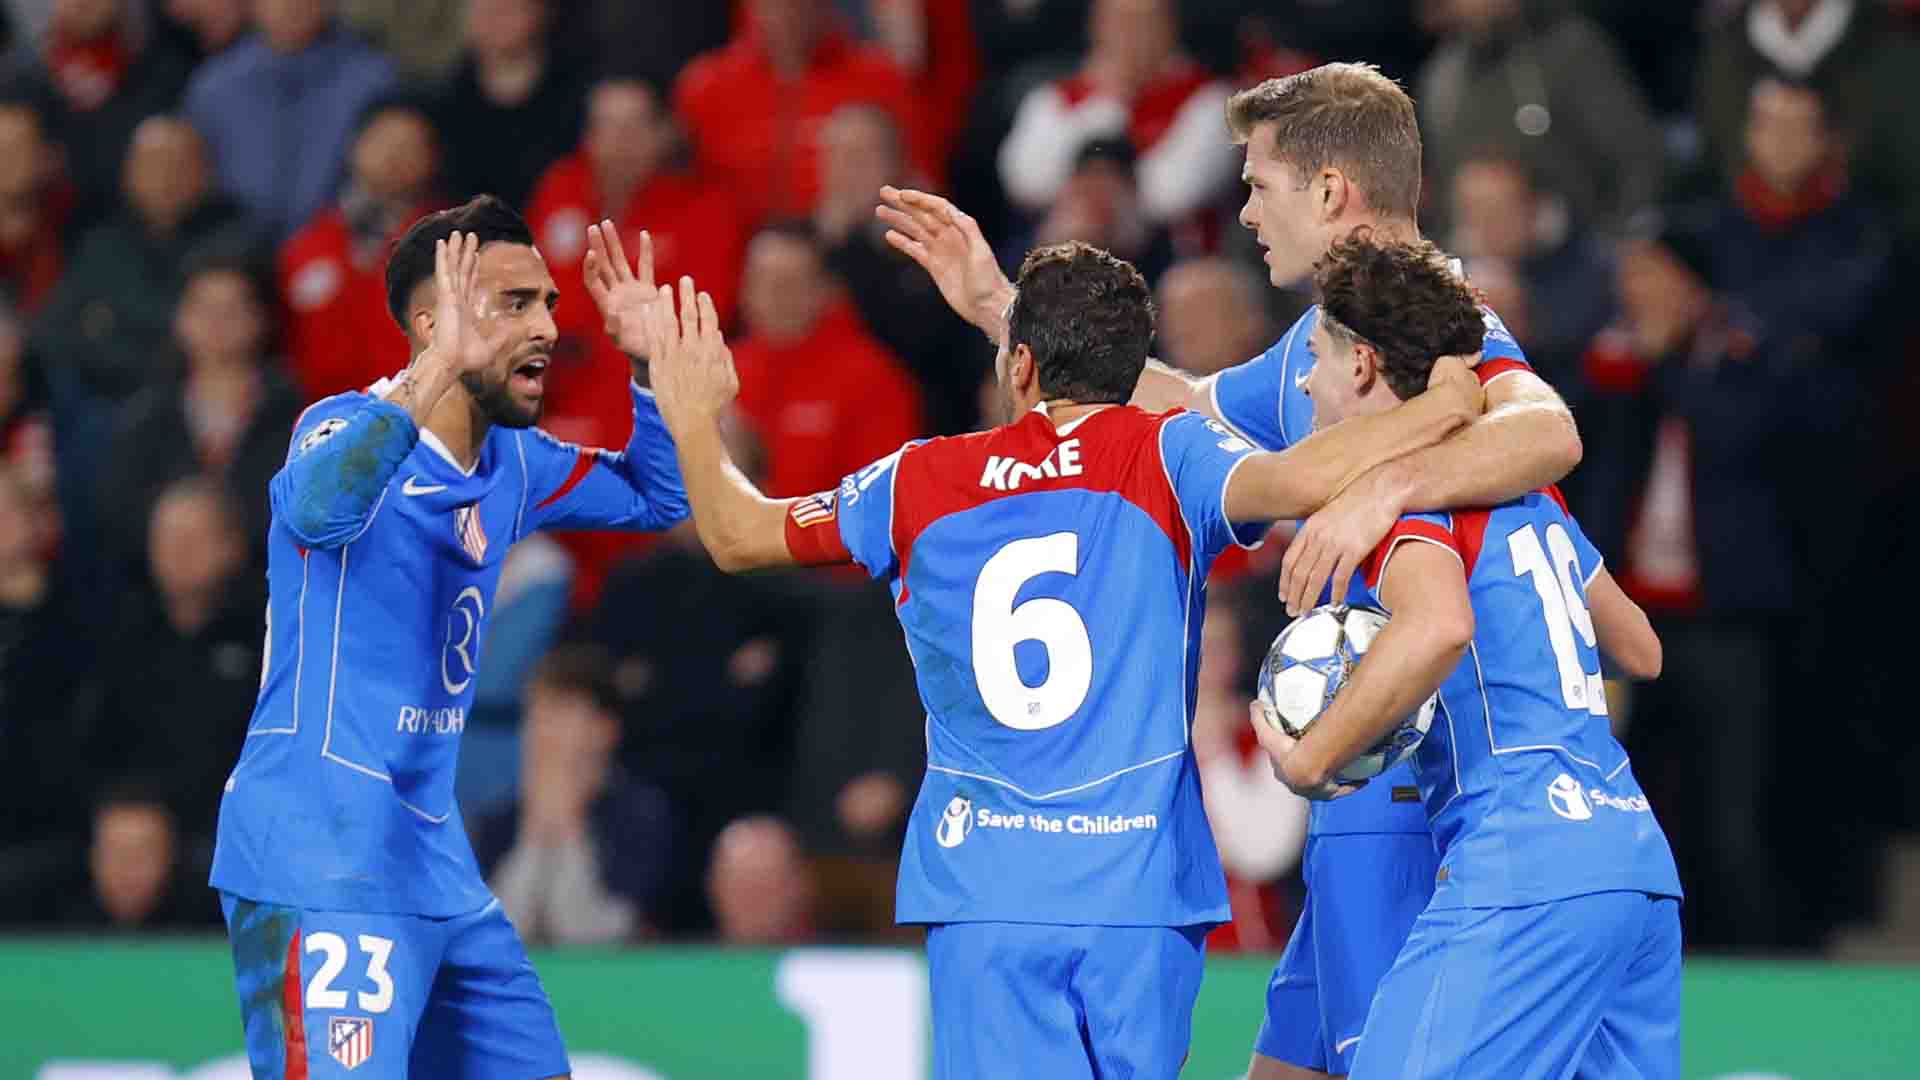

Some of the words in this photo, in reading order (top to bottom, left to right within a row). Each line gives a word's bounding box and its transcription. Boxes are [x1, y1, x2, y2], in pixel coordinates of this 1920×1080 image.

[972, 531, 1093, 731] 6
[976, 808, 1025, 829] Save
[1029, 814, 1064, 833] the
[1066, 814, 1158, 834] Children
[305, 931, 394, 1013] 23
